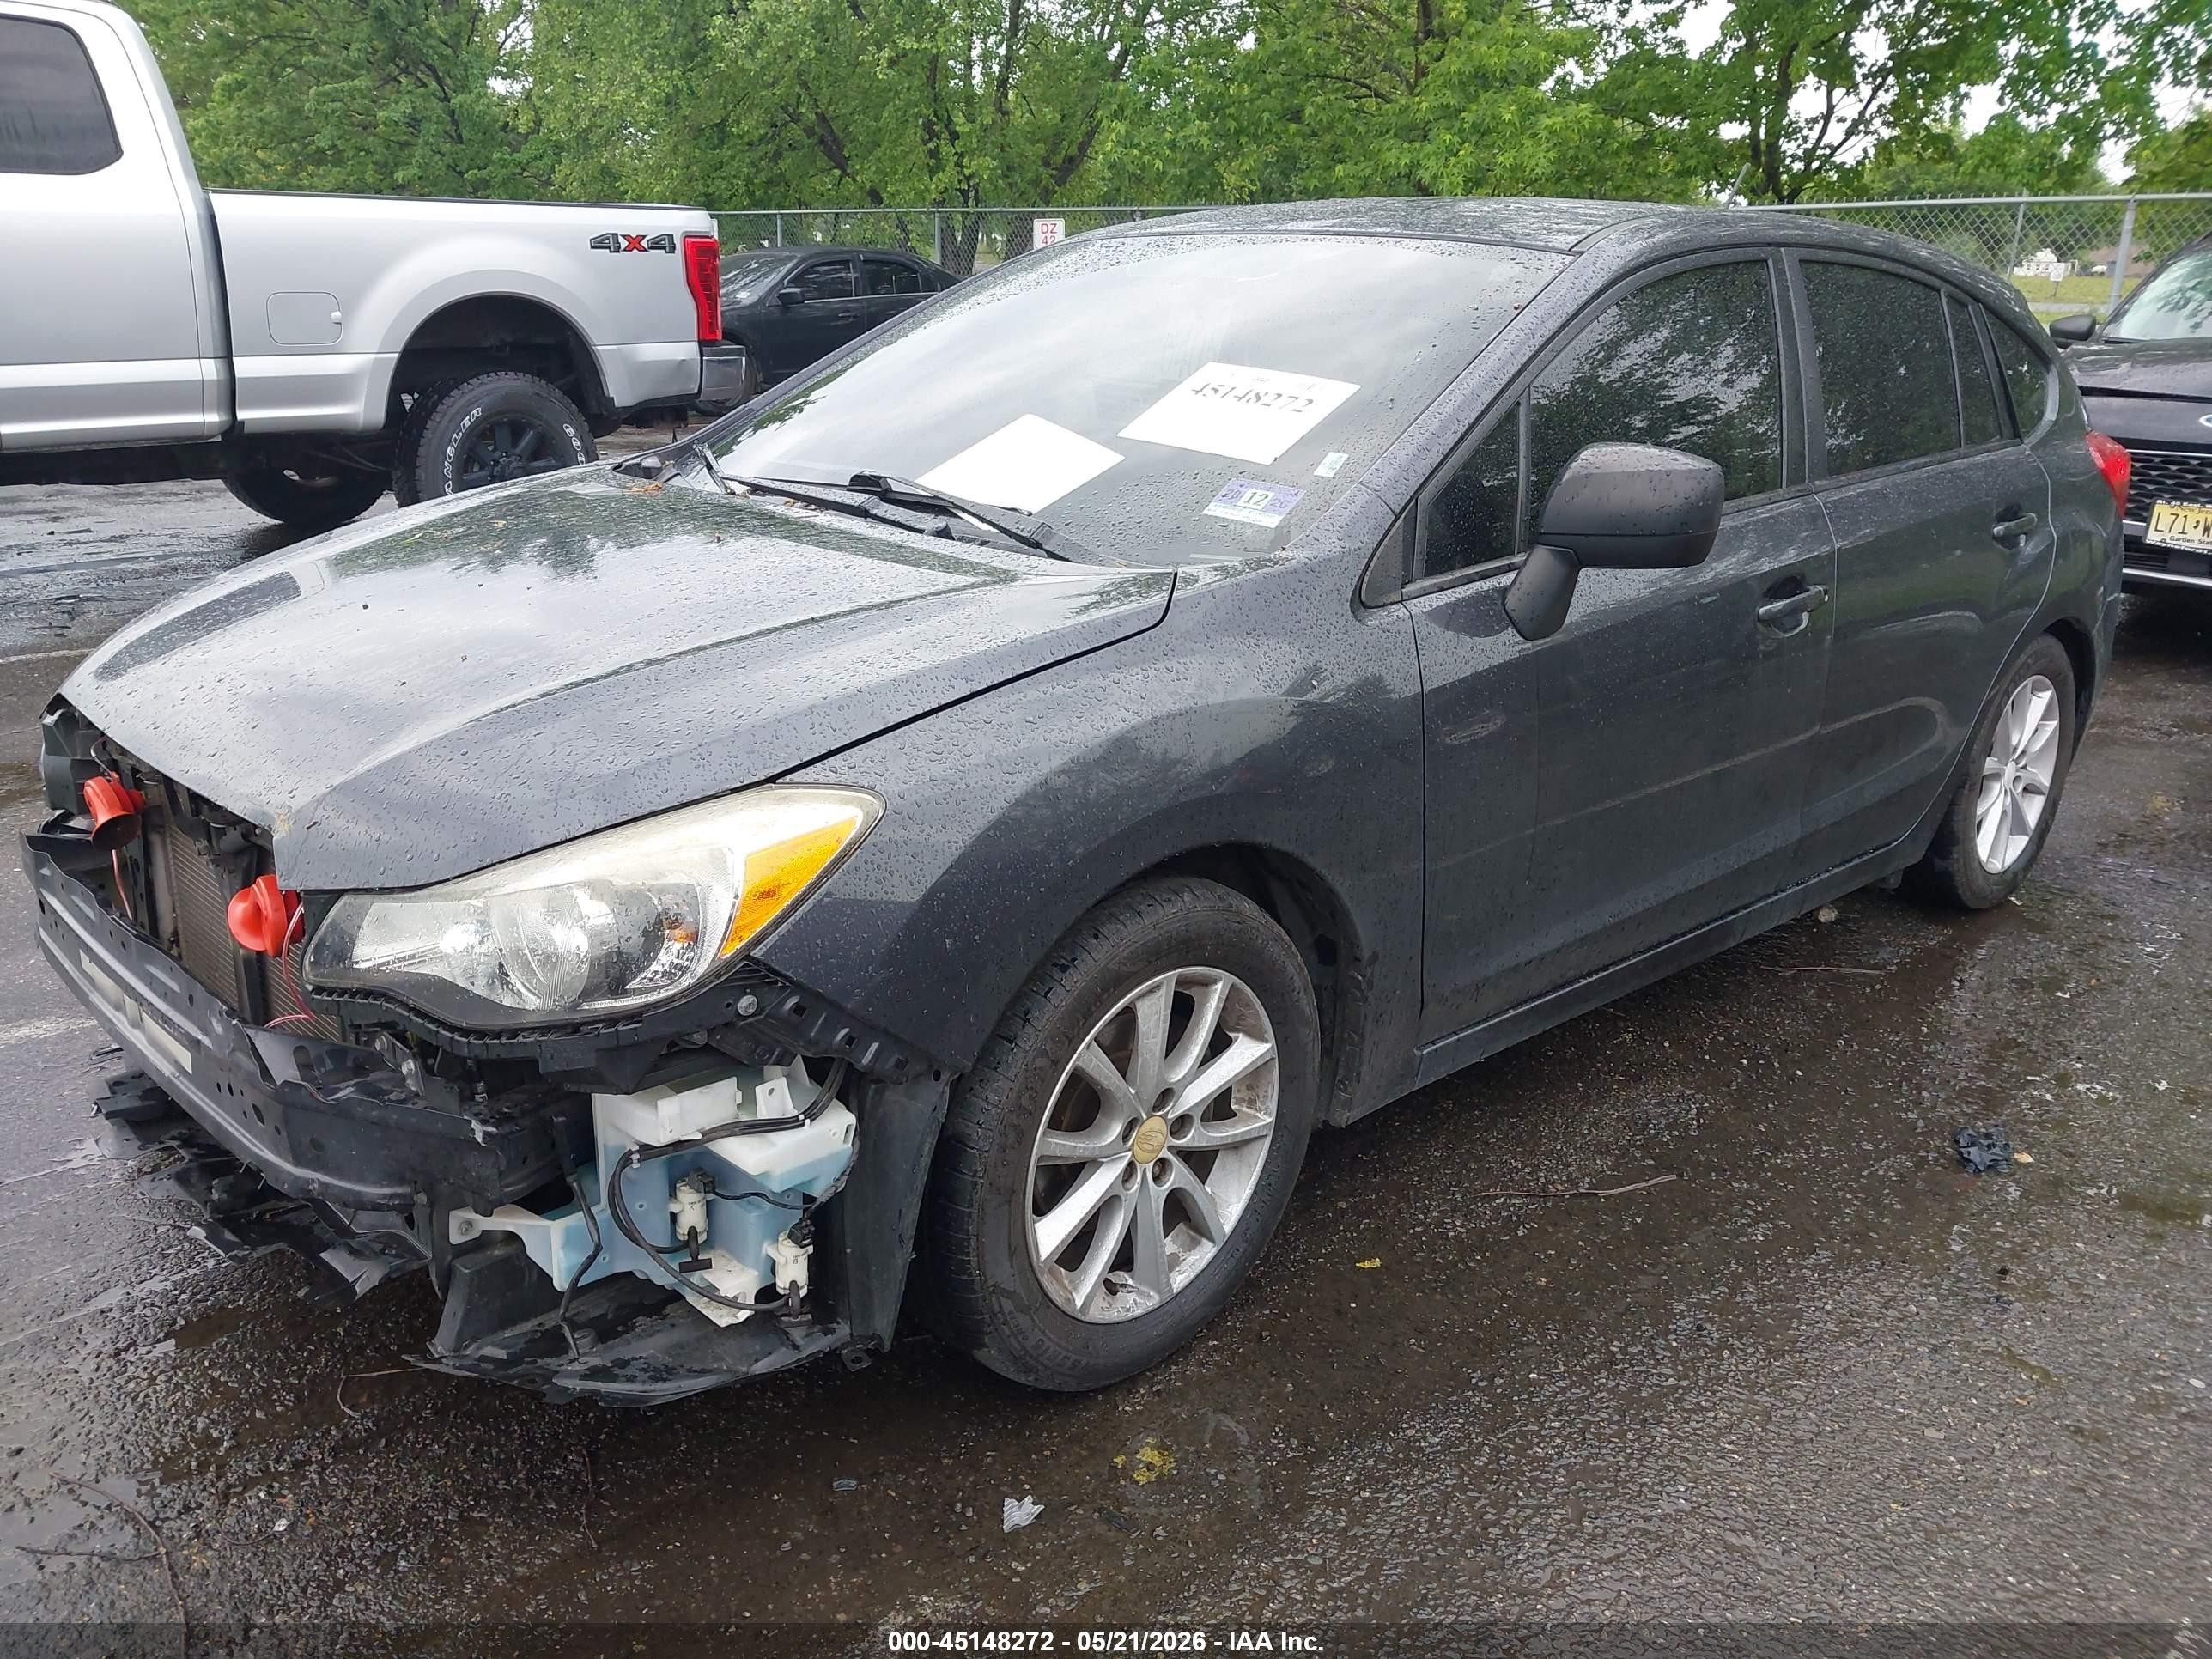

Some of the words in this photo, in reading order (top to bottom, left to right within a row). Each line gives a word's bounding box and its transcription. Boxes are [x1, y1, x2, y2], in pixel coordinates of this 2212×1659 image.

[1041, 223, 1058, 234] DZ
[1042, 235, 1056, 245] 42
[1192, 383, 1315, 413] 45148272
[1248, 491, 1269, 507] 12
[2154, 512, 2188, 535] L71
[2169, 535, 2195, 544] Garden
